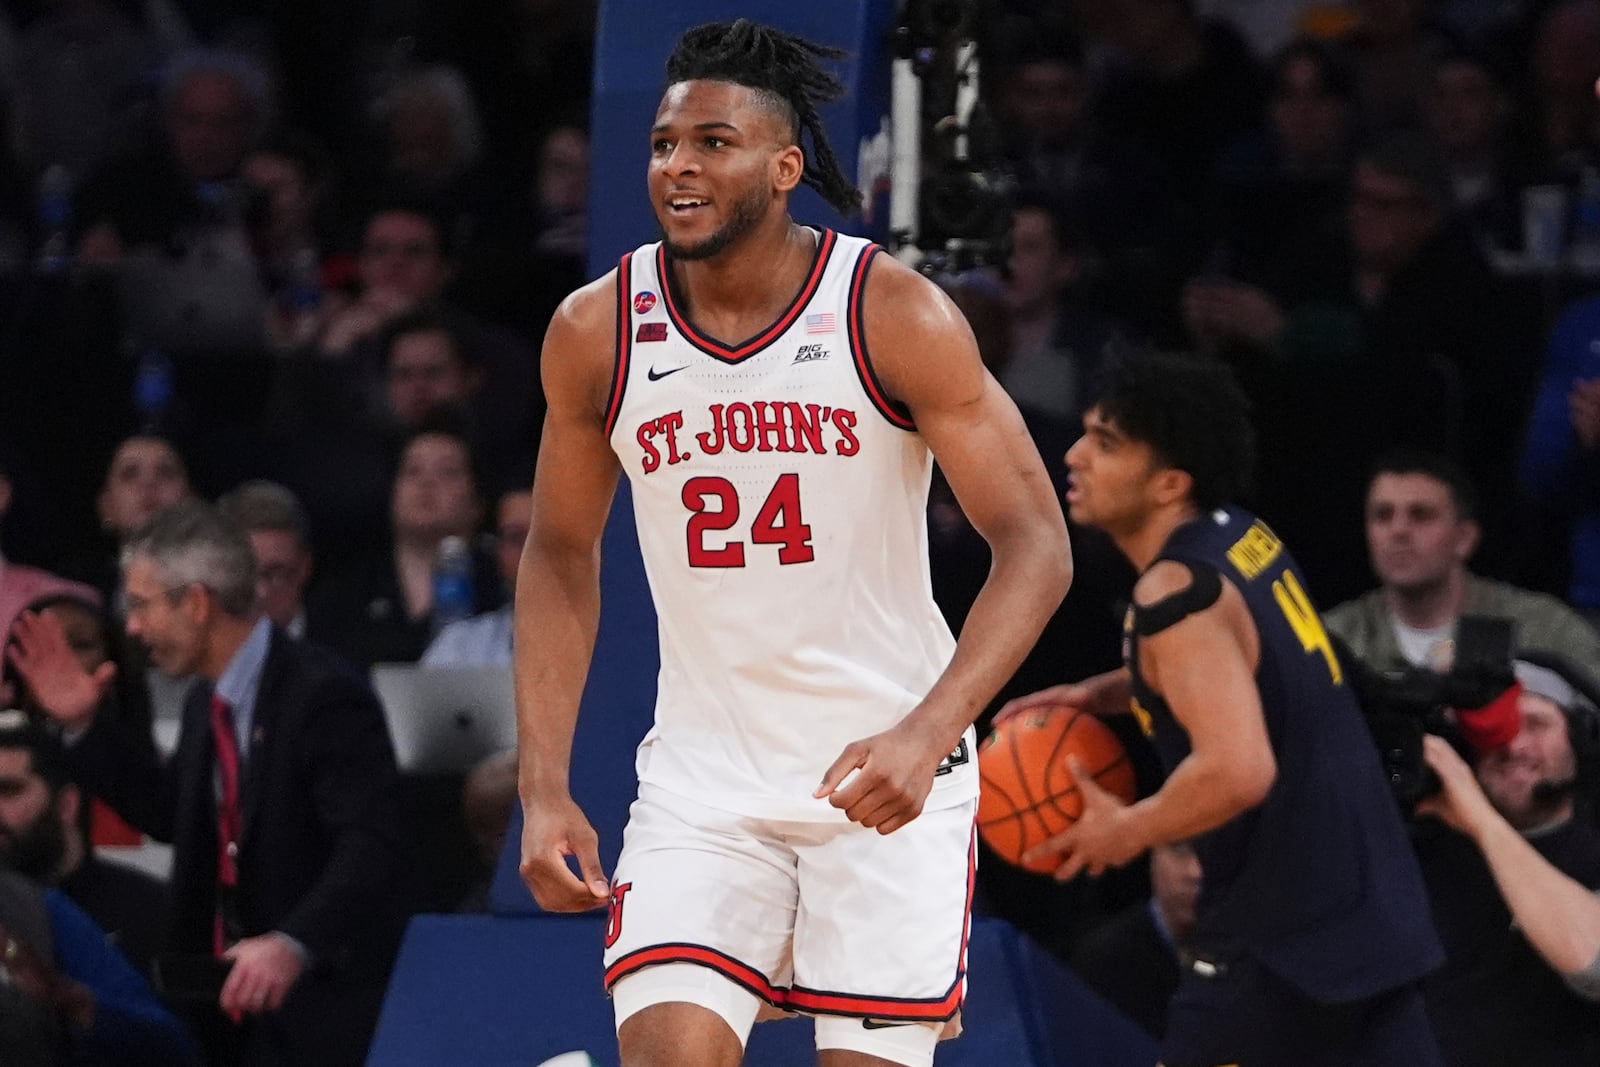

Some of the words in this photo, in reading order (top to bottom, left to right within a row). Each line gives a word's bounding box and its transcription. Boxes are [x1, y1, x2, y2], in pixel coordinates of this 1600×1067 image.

[794, 350, 831, 361] EAST
[798, 344, 823, 353] BIG
[637, 410, 691, 474] ST.
[696, 401, 860, 456] JOHN'S
[682, 473, 814, 568] 24
